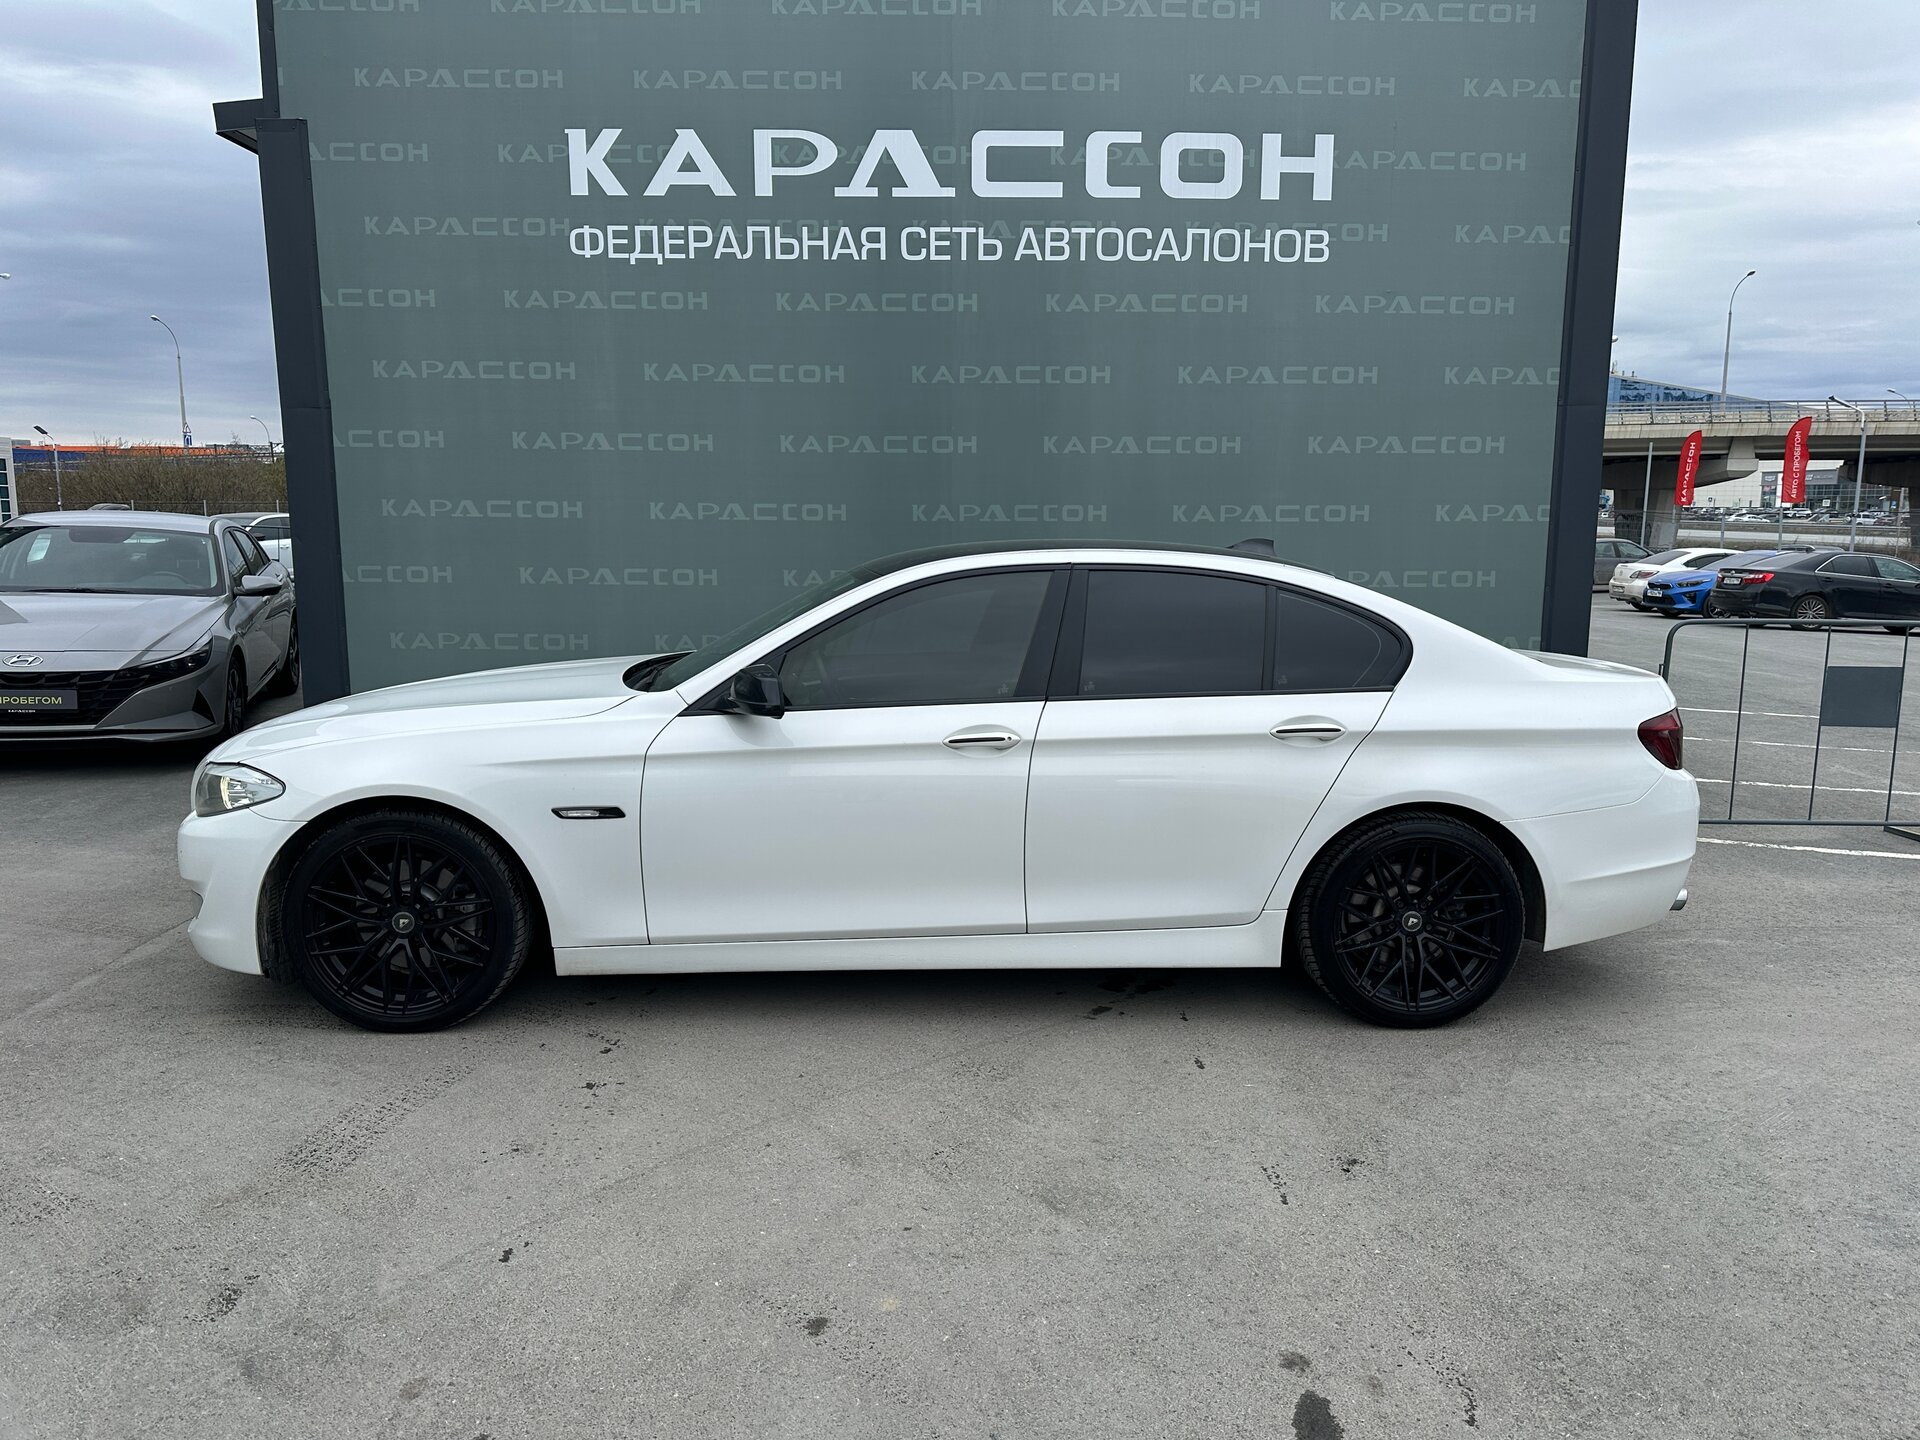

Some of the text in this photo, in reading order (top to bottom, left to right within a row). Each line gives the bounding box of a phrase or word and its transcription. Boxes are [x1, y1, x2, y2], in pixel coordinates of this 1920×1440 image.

[569, 224, 1330, 265] ФЕДЕРАЛЬНАЯ СЕТЬ АВТОСАЛОНОВ
[1793, 430, 1802, 472] ПРОБЕГОМ
